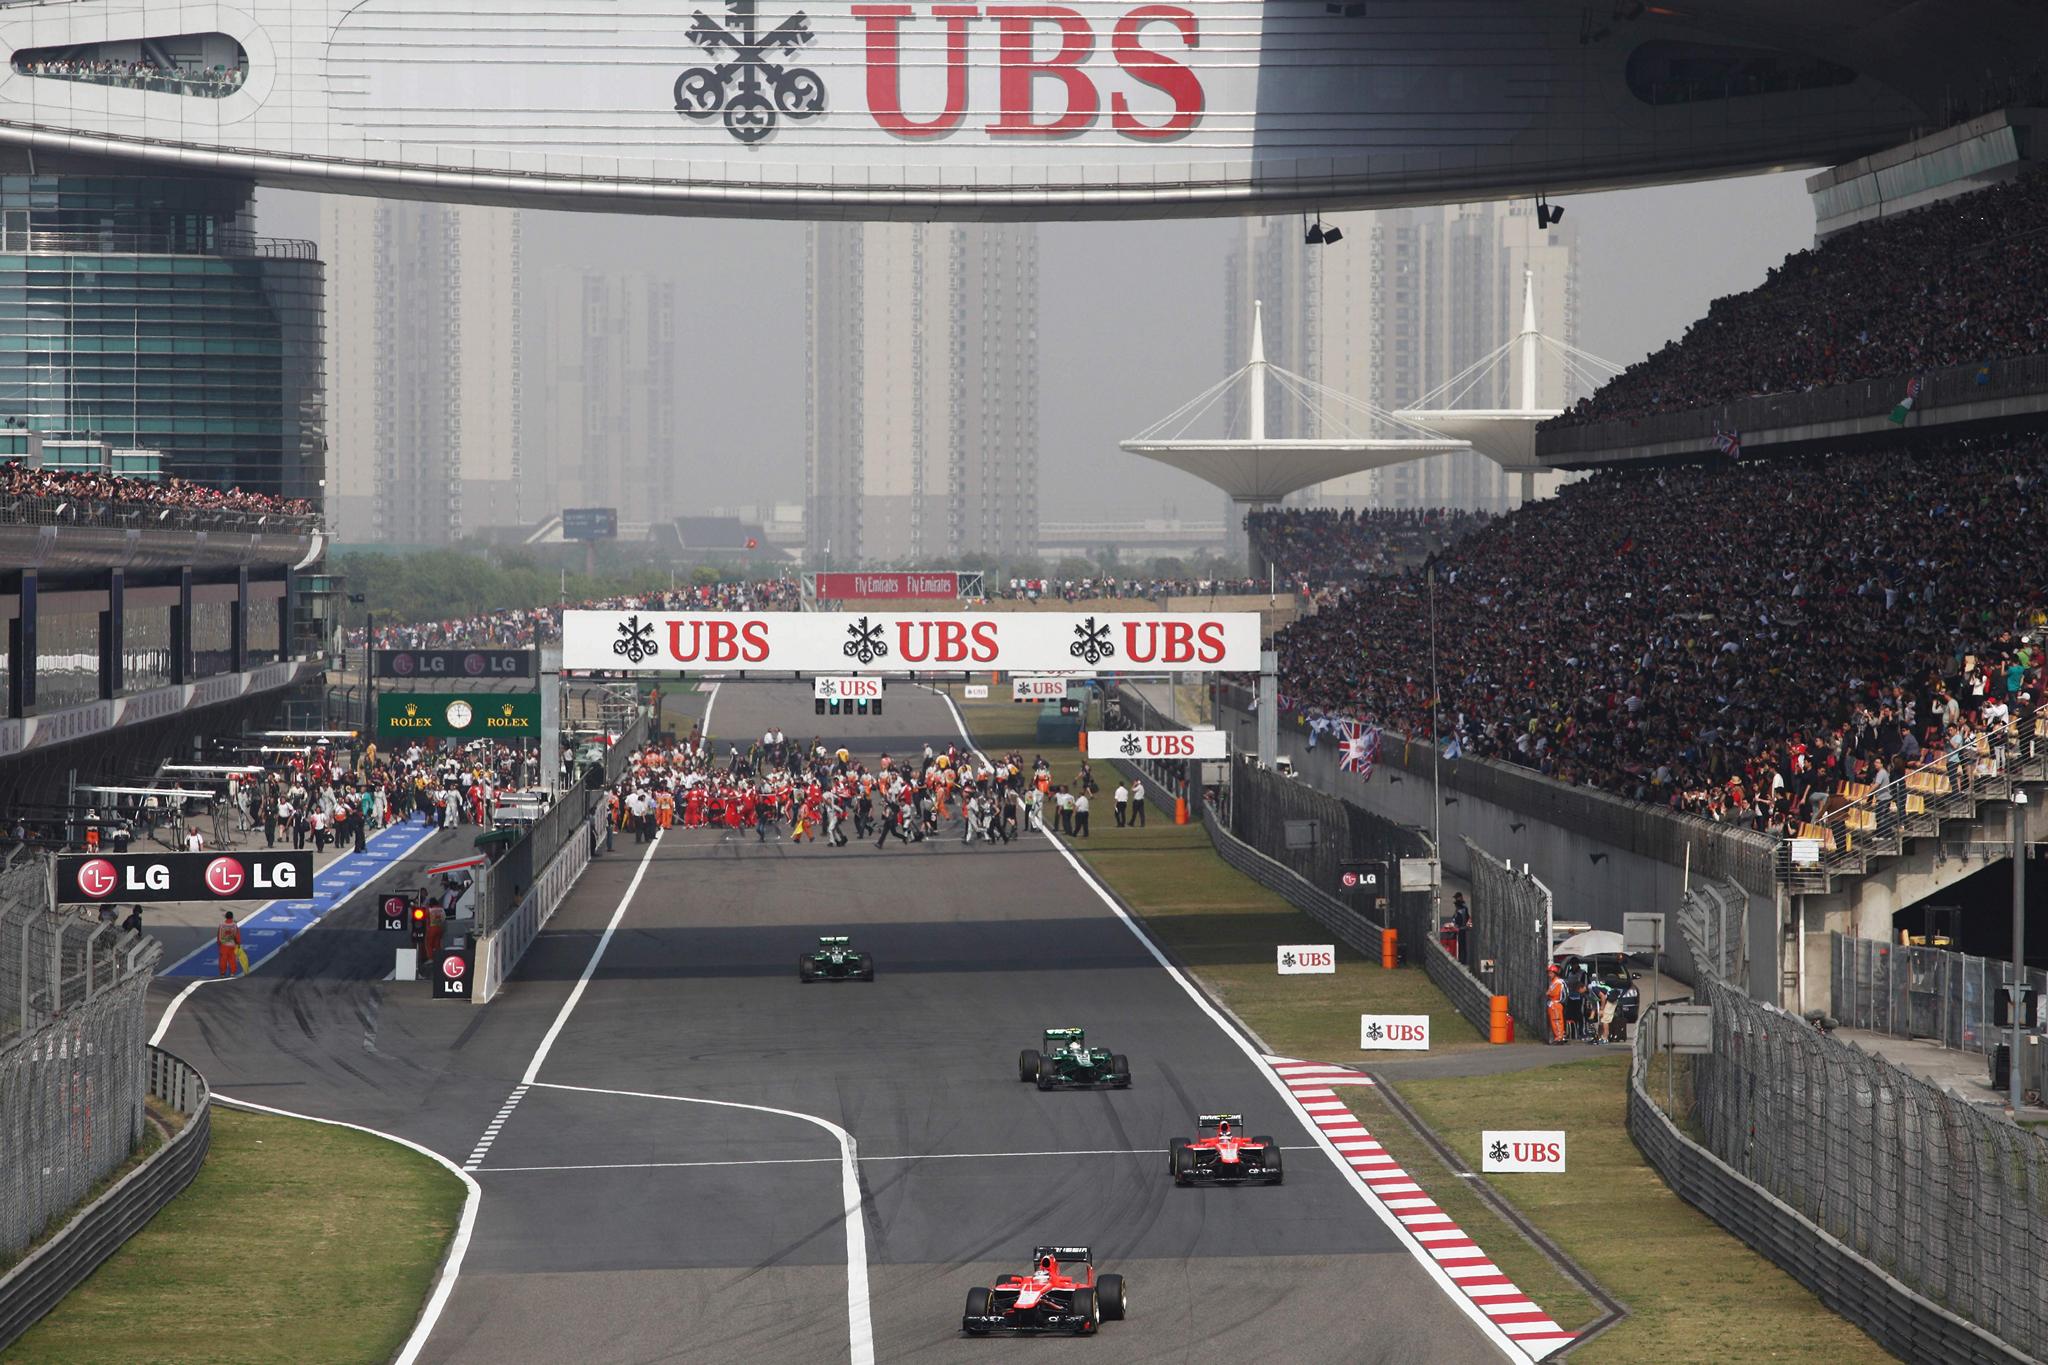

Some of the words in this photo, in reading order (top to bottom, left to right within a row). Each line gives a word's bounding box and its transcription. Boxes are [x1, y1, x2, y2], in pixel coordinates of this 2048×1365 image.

[850, 4, 1205, 140] UBS
[855, 576, 867, 595] Fly
[868, 576, 899, 593] Emirates
[907, 576, 919, 595] Fly
[920, 576, 951, 593] Emirates
[664, 620, 771, 663] UBS
[896, 620, 1000, 663] UBS
[1121, 620, 1228, 664] UBS
[419, 656, 445, 672] LG
[490, 656, 516, 672] LG
[839, 680, 878, 696] UBS
[1032, 682, 1063, 694] UBS
[390, 717, 432, 727] ROLEX
[487, 717, 529, 727] ROLEX
[1145, 735, 1195, 756] UBS
[126, 864, 170, 890] LG
[253, 862, 296, 888] LG
[1359, 873, 1376, 885] LG
[385, 919, 402, 930] LG
[1298, 952, 1332, 967] UBS
[444, 980, 464, 993] LG
[1386, 1024, 1426, 1042] UBS
[1513, 1142, 1562, 1163] UBS
